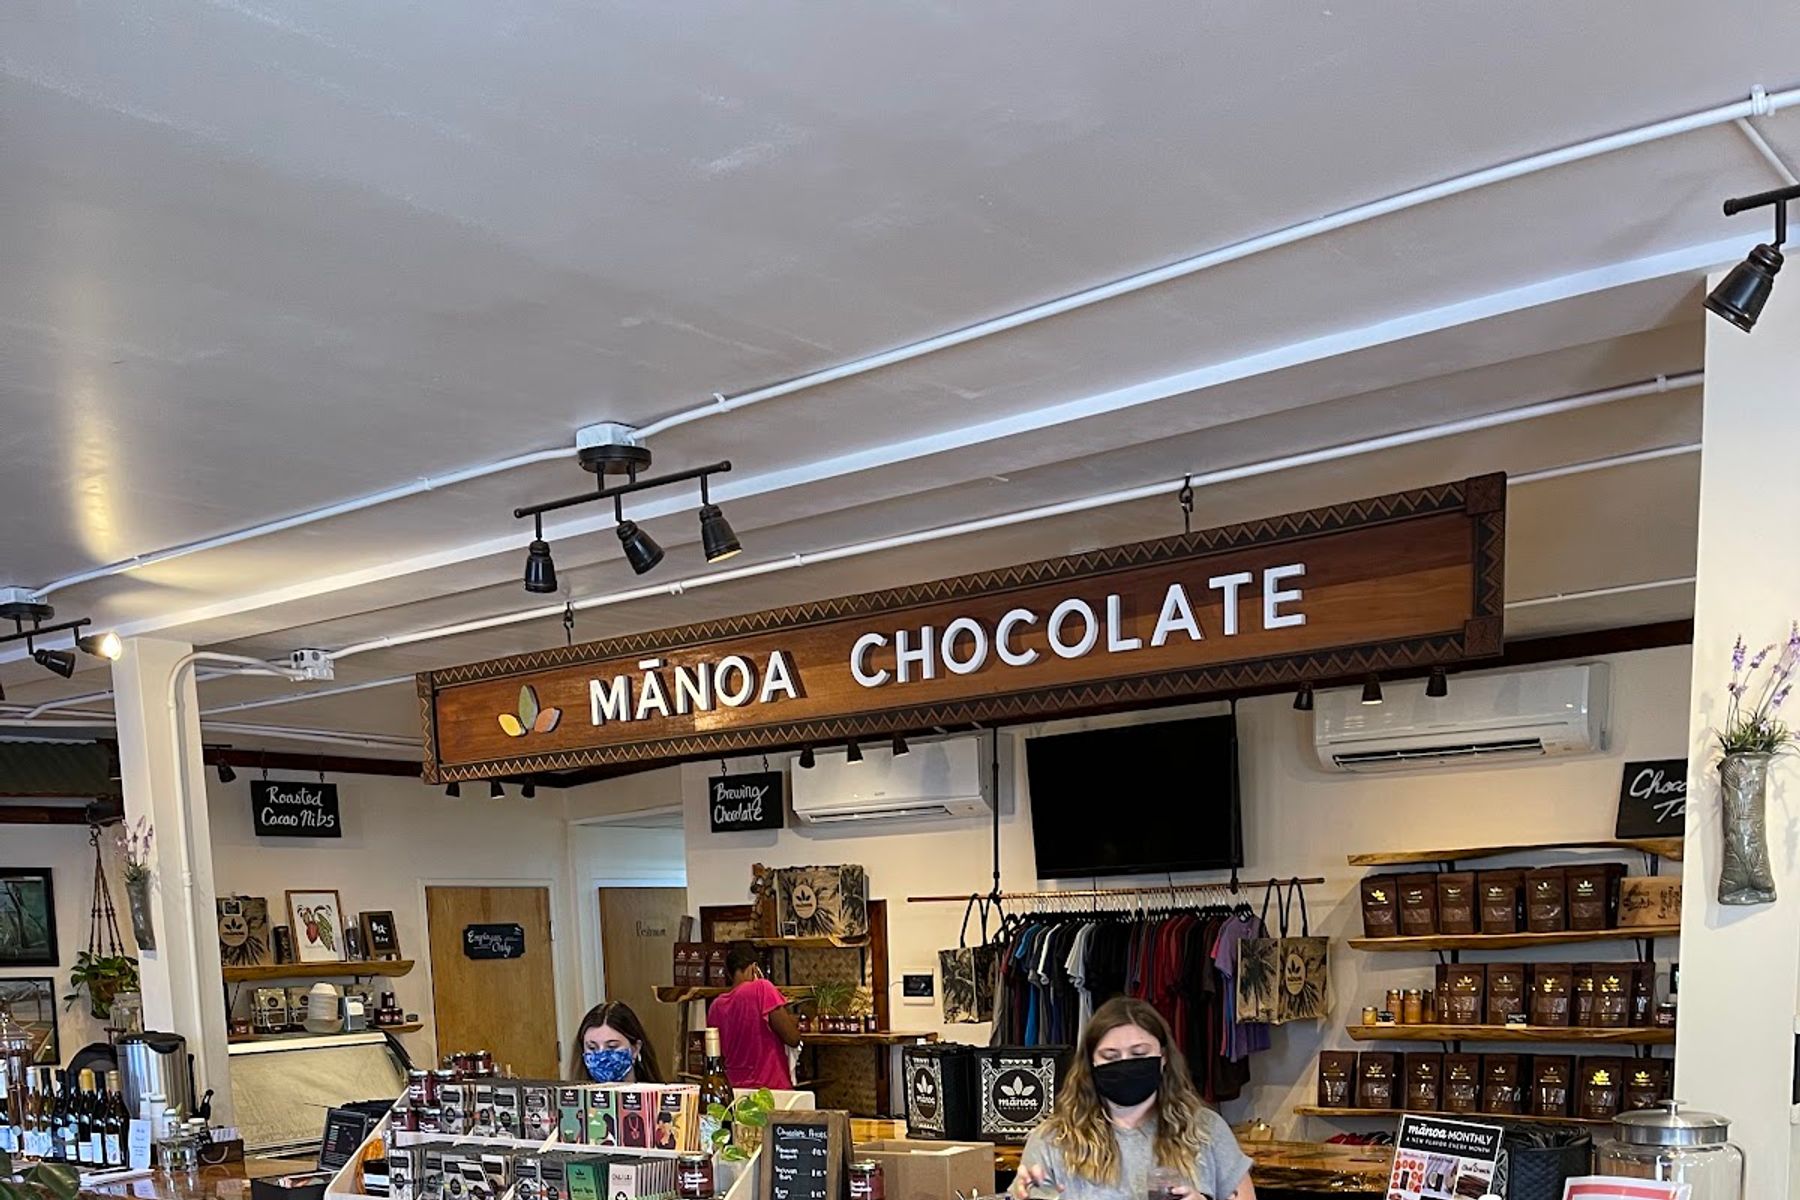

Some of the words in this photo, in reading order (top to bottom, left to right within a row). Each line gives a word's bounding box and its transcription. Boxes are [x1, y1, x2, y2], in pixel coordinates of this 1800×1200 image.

[589, 650, 799, 726] MĀNOA
[850, 563, 1306, 688] CHOCOLATE
[265, 786, 324, 807] Roasted
[713, 782, 769, 813] Brewing
[261, 807, 298, 826] Cacao
[300, 808, 335, 828] Nibs
[713, 802, 763, 825] Chocolate
[998, 1096, 1039, 1107] mānoa
[1408, 1123, 1447, 1139] mānoa
[1447, 1130, 1493, 1146] MONTHLY
[1425, 1139, 1447, 1147] FLAVOR
[1448, 1142, 1467, 1150] EVERY
